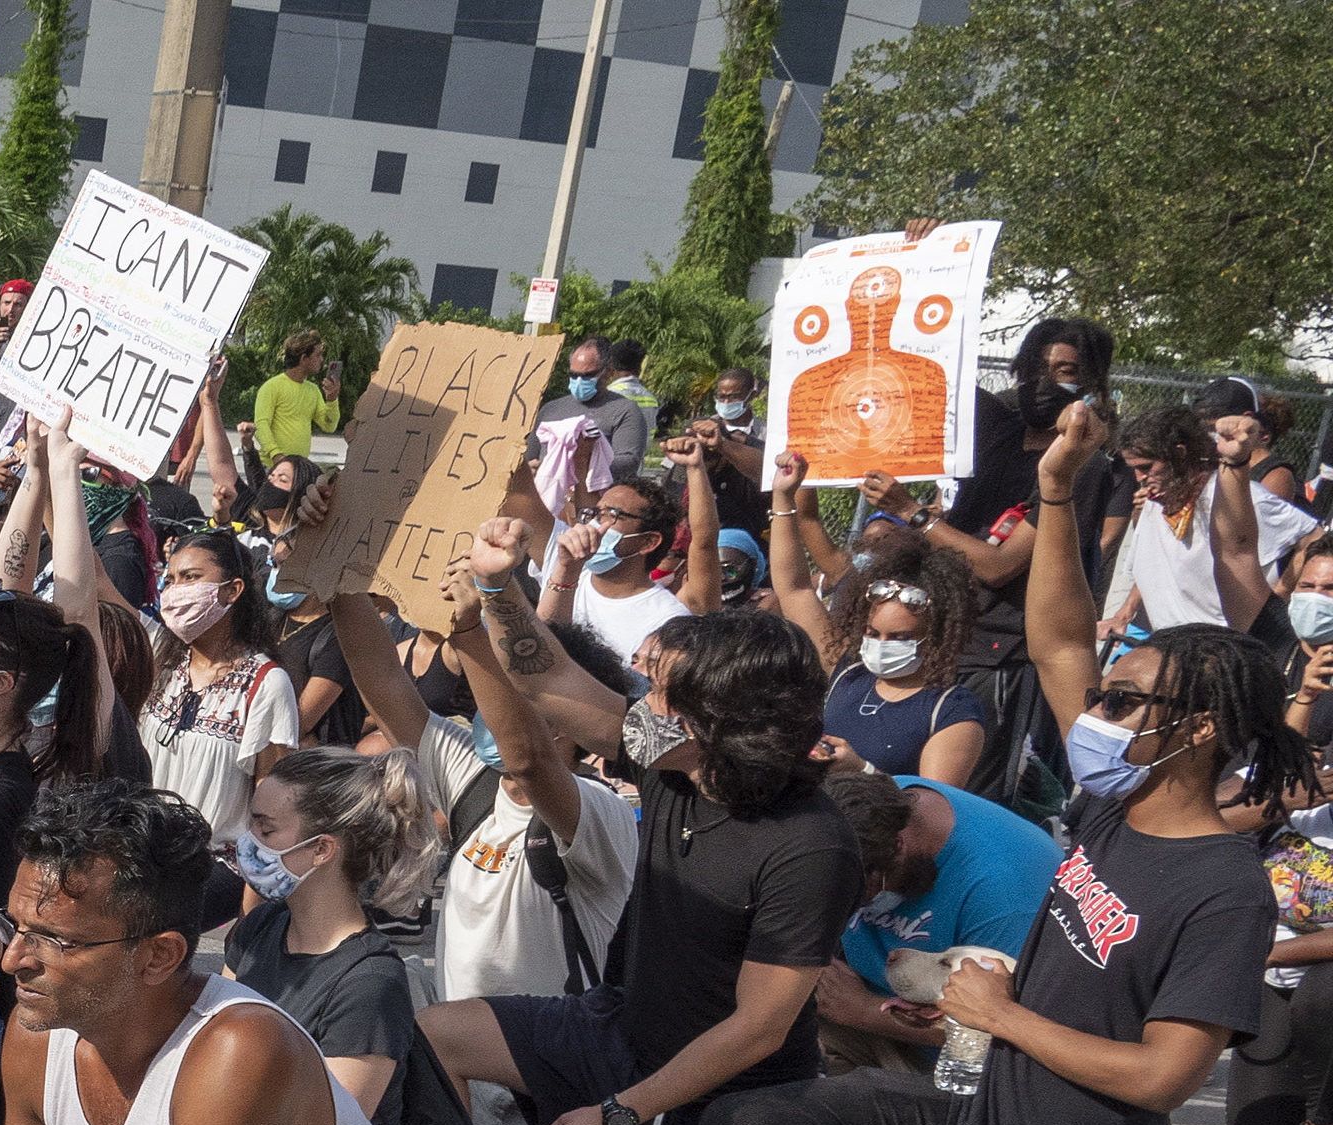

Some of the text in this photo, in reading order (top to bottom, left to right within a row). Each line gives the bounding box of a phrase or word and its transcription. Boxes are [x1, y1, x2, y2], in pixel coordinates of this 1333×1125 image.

[73, 196, 126, 262] I
[116, 218, 249, 313] CANT
[19, 286, 194, 438] BREATHE
[377, 345, 546, 427] BLACK
[362, 430, 506, 491] LIVES
